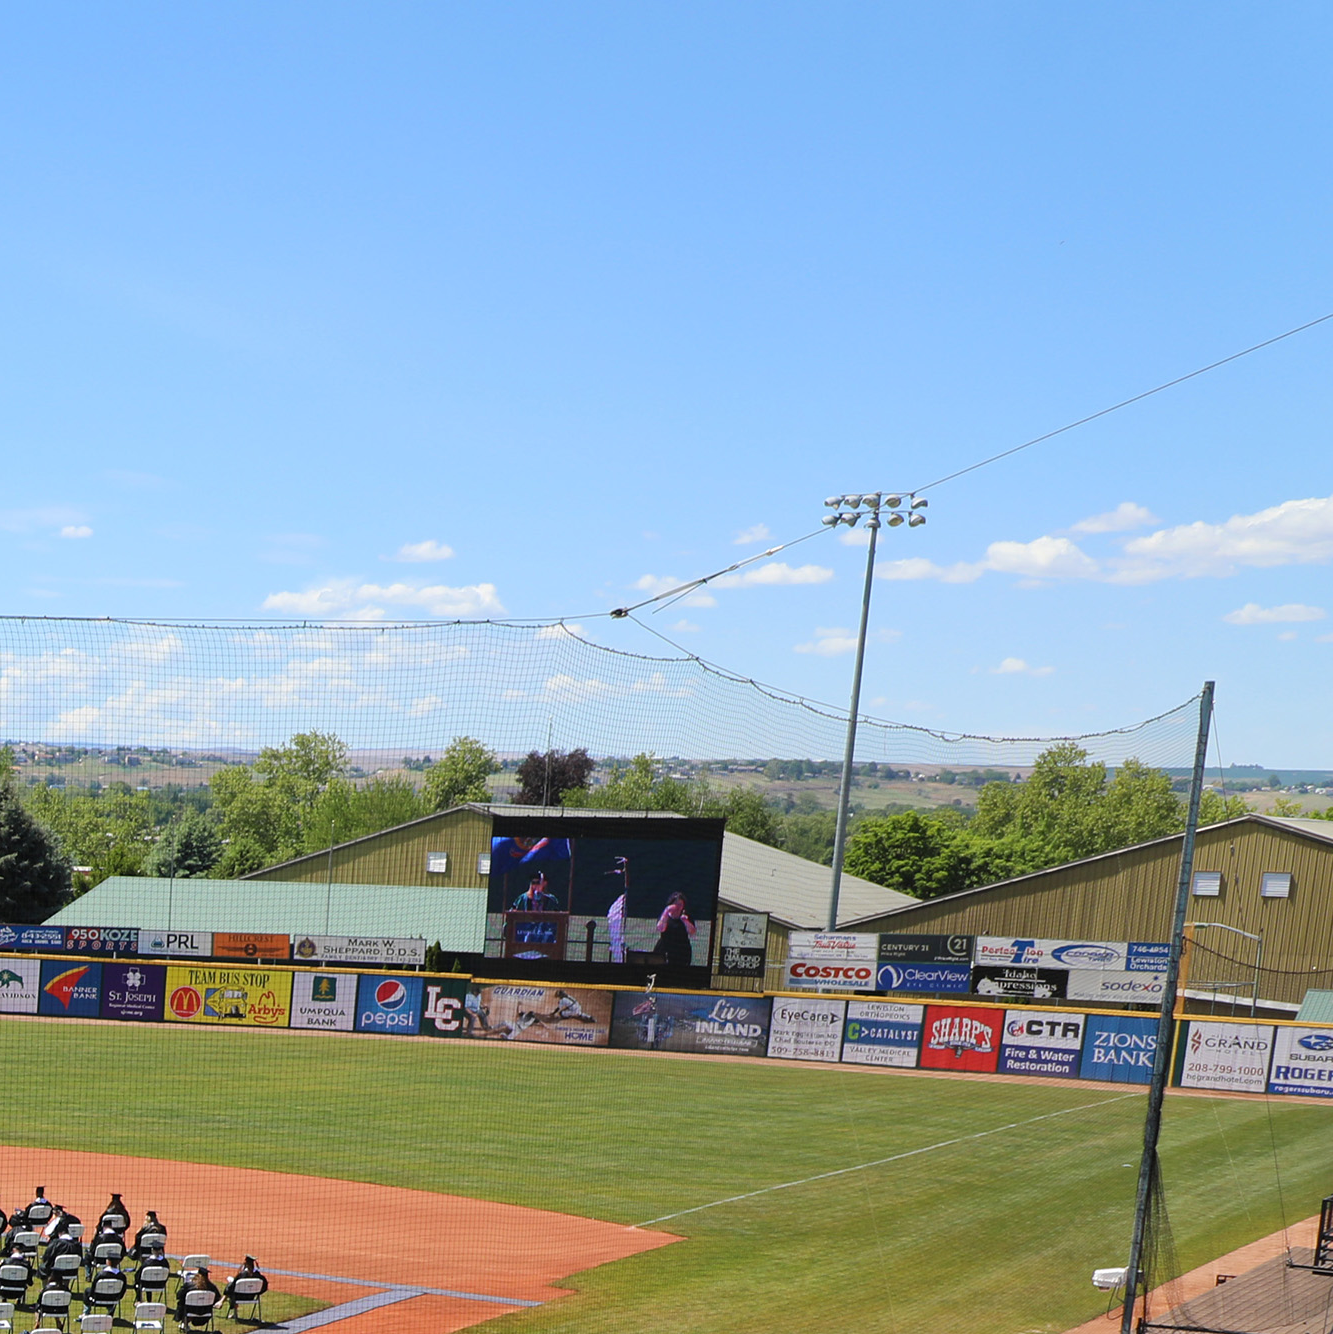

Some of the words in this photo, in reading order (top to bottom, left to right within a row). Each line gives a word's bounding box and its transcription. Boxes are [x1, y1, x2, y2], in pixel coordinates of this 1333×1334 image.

[71, 929, 99, 940] 950
[99, 929, 138, 941] KOZE
[166, 933, 200, 950] PRL
[66, 941, 138, 951] SPORTS
[323, 945, 383, 956] SHEPPARD,
[347, 938, 380, 948] MARK
[382, 939, 396, 949] W.
[881, 943, 919, 951] CENTURY
[953, 938, 967, 950] 21
[789, 962, 872, 980] COSTCO
[904, 968, 969, 982] ClearView
[188, 969, 217, 986] TEAM
[219, 970, 241, 986] BUS
[242, 972, 271, 989] STOP
[813, 979, 870, 987] WHOLESALE
[62, 985, 98, 994] BANNER
[493, 986, 545, 997] GUARDIAN
[1100, 980, 1163, 993] sodexo
[73, 992, 98, 1000] BANK
[123, 991, 157, 1003] JOSEPH
[247, 1003, 286, 1017] Arby's
[299, 1007, 347, 1017] UMPQUA
[424, 985, 462, 1031] LC
[708, 999, 751, 1021] Live
[306, 1017, 338, 1027] BANK
[361, 1010, 414, 1029] pepsi
[780, 1008, 829, 1024] EyeCare
[859, 1011, 911, 1021] ORTHOPEDICS
[694, 1020, 763, 1038] INLAND
[869, 1028, 919, 1041] CATALYST
[930, 1016, 993, 1049] SHARP'S
[1025, 1019, 1081, 1039] CTR
[564, 1031, 595, 1042] HOME
[1093, 1031, 1158, 1049] ZIONS
[1204, 1036, 1269, 1051] GRAND
[1004, 1047, 1026, 1059] Fire
[1027, 1049, 1038, 1059] &
[1040, 1051, 1075, 1062] Water
[1091, 1047, 1155, 1068] BANK
[1005, 1059, 1071, 1074] Restoration
[1187, 1062, 1264, 1077] 208-799-1000
